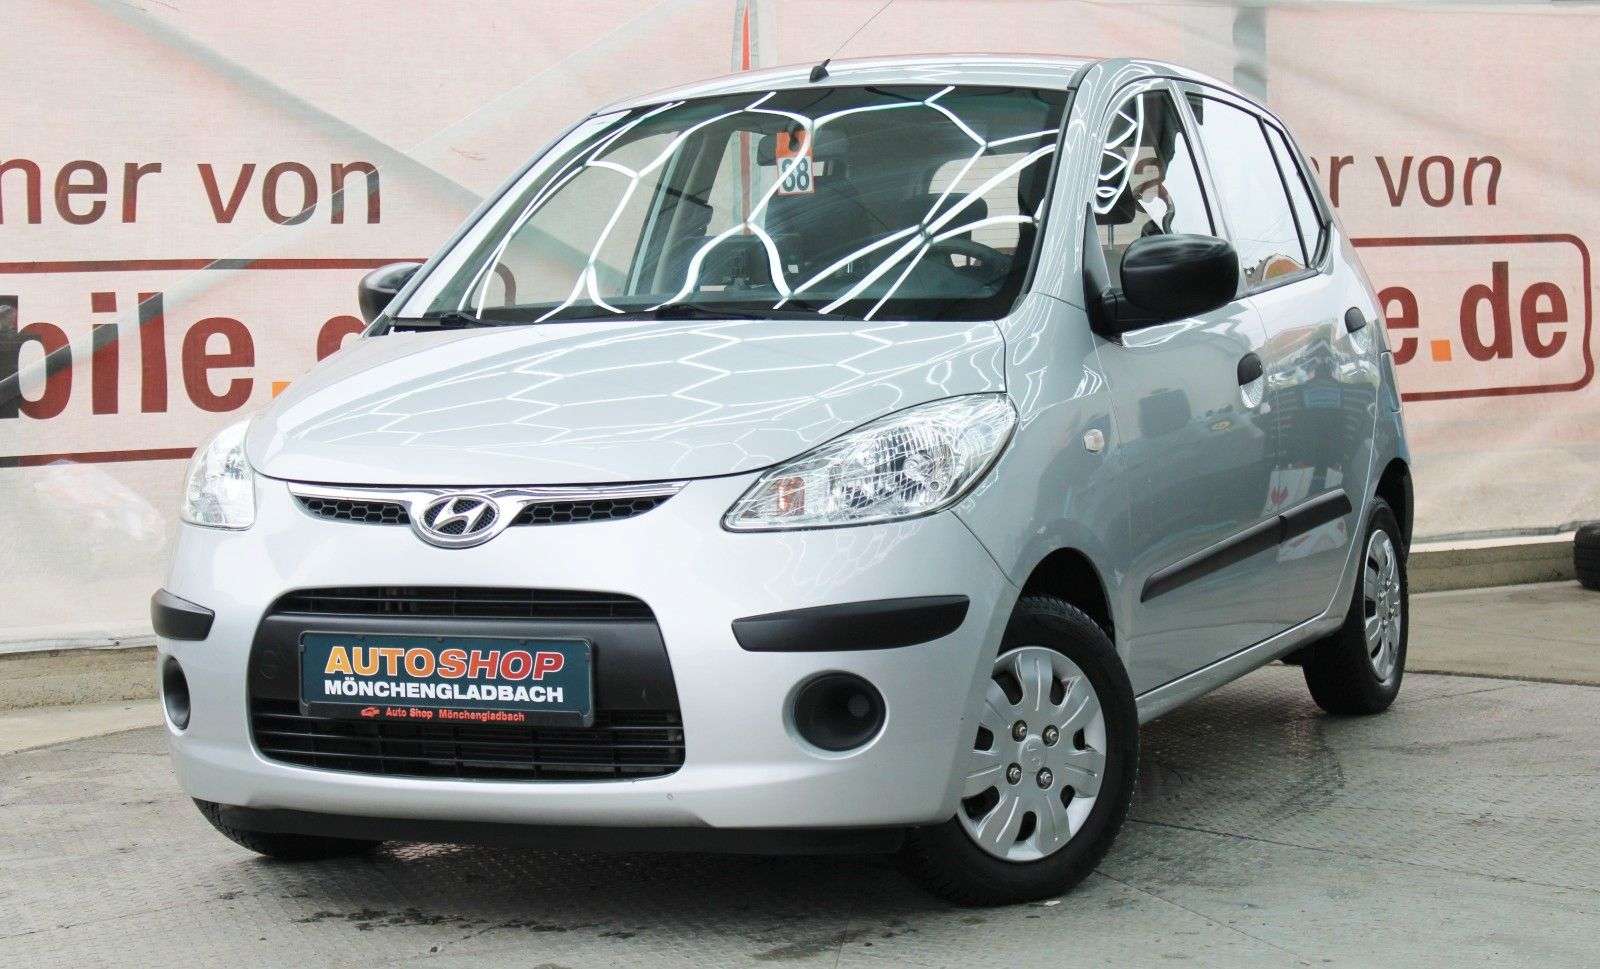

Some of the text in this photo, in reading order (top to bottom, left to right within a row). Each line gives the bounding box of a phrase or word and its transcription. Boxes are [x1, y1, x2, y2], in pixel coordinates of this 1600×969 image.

[197, 160, 381, 226] von
[1375, 155, 1502, 208] von
[324, 645, 565, 681] AUTOSHOP
[324, 677, 564, 703] MÖNCHENGLADBACH
[385, 707, 525, 722] Auto Shop Mönchengladbach
